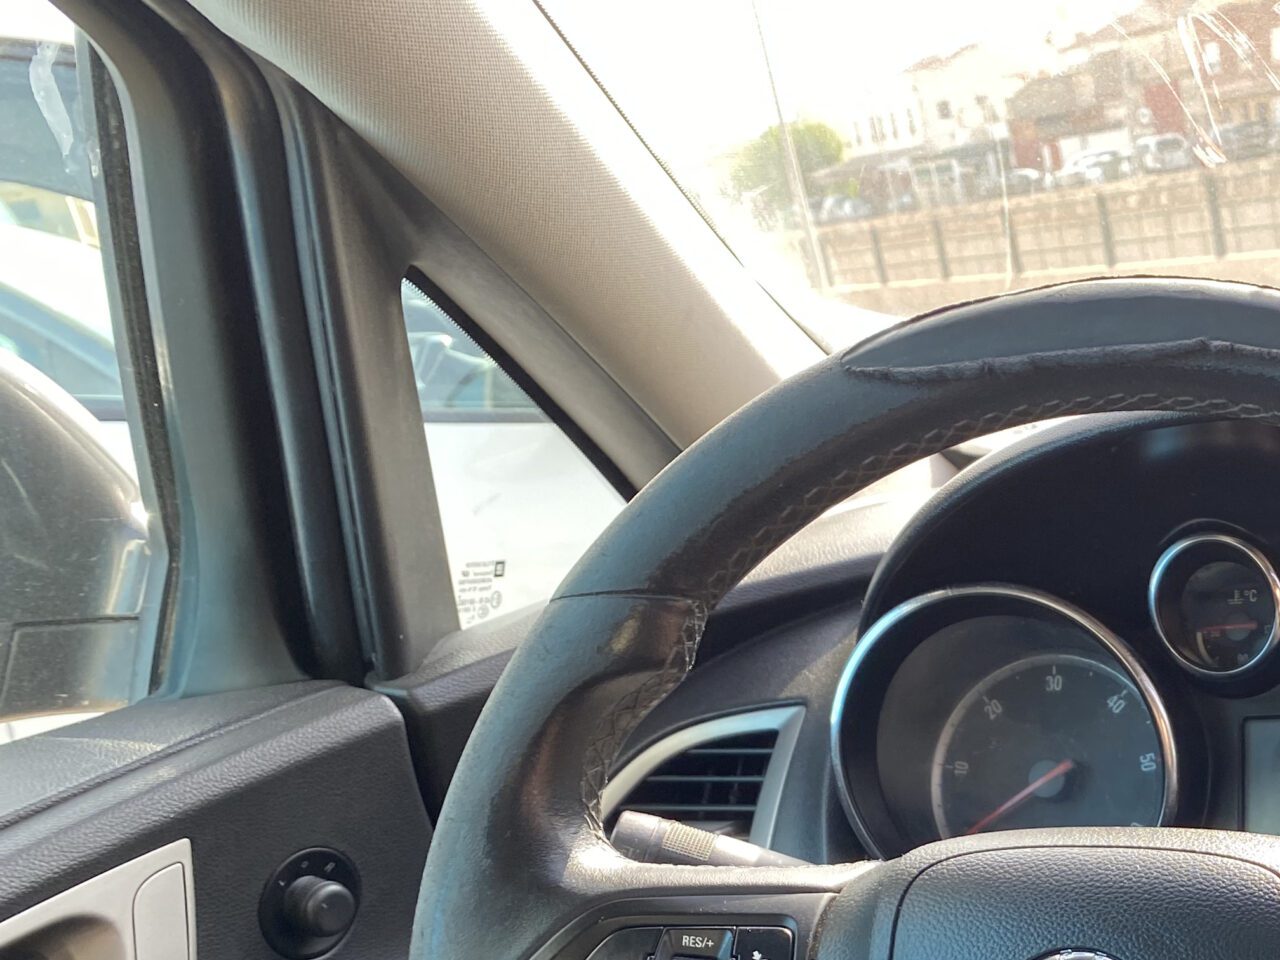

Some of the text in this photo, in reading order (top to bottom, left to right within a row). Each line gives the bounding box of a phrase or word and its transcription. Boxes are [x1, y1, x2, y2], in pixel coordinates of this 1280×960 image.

[1046, 675, 1063, 691] 30
[984, 698, 1003, 720] 20
[1106, 695, 1125, 714] 40
[954, 760, 969, 776] 10
[1139, 752, 1157, 772] 50
[681, 934, 715, 949] RES/+
